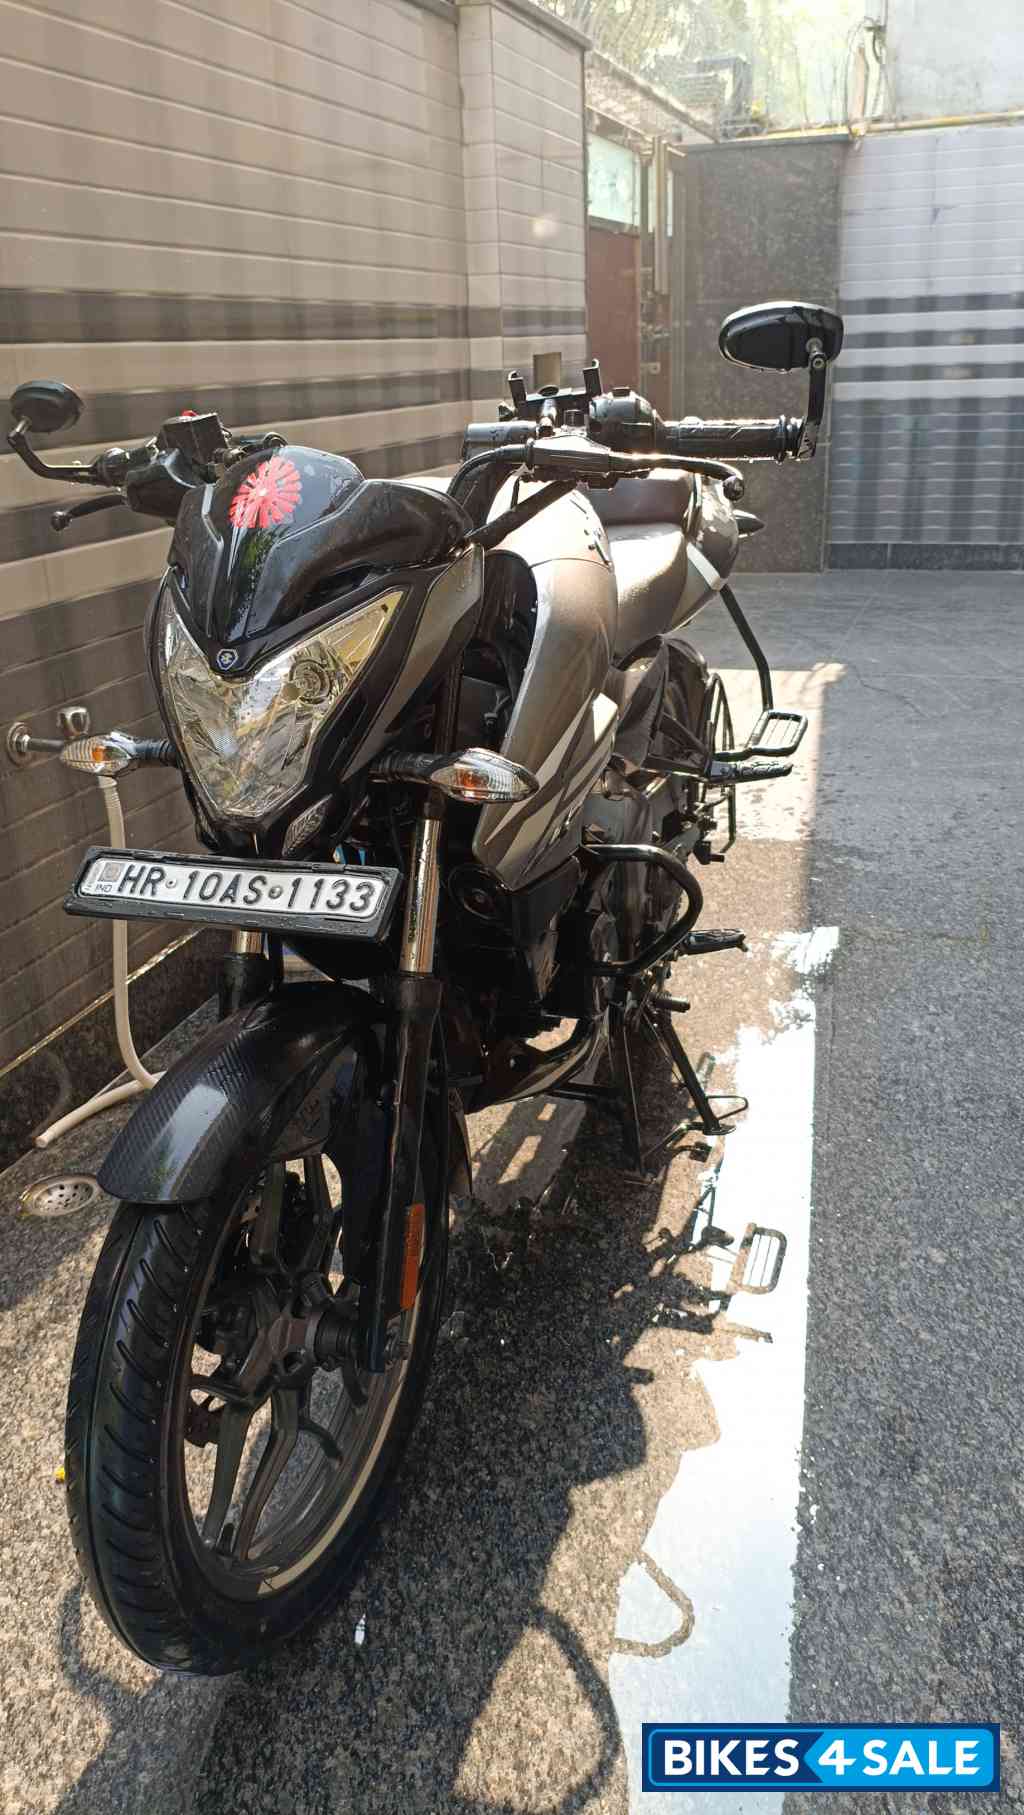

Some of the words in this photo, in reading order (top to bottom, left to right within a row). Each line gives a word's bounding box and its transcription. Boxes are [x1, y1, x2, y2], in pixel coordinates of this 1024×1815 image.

[117, 864, 166, 897] HR
[183, 870, 266, 906] 10AS
[288, 877, 377, 912] 1133
